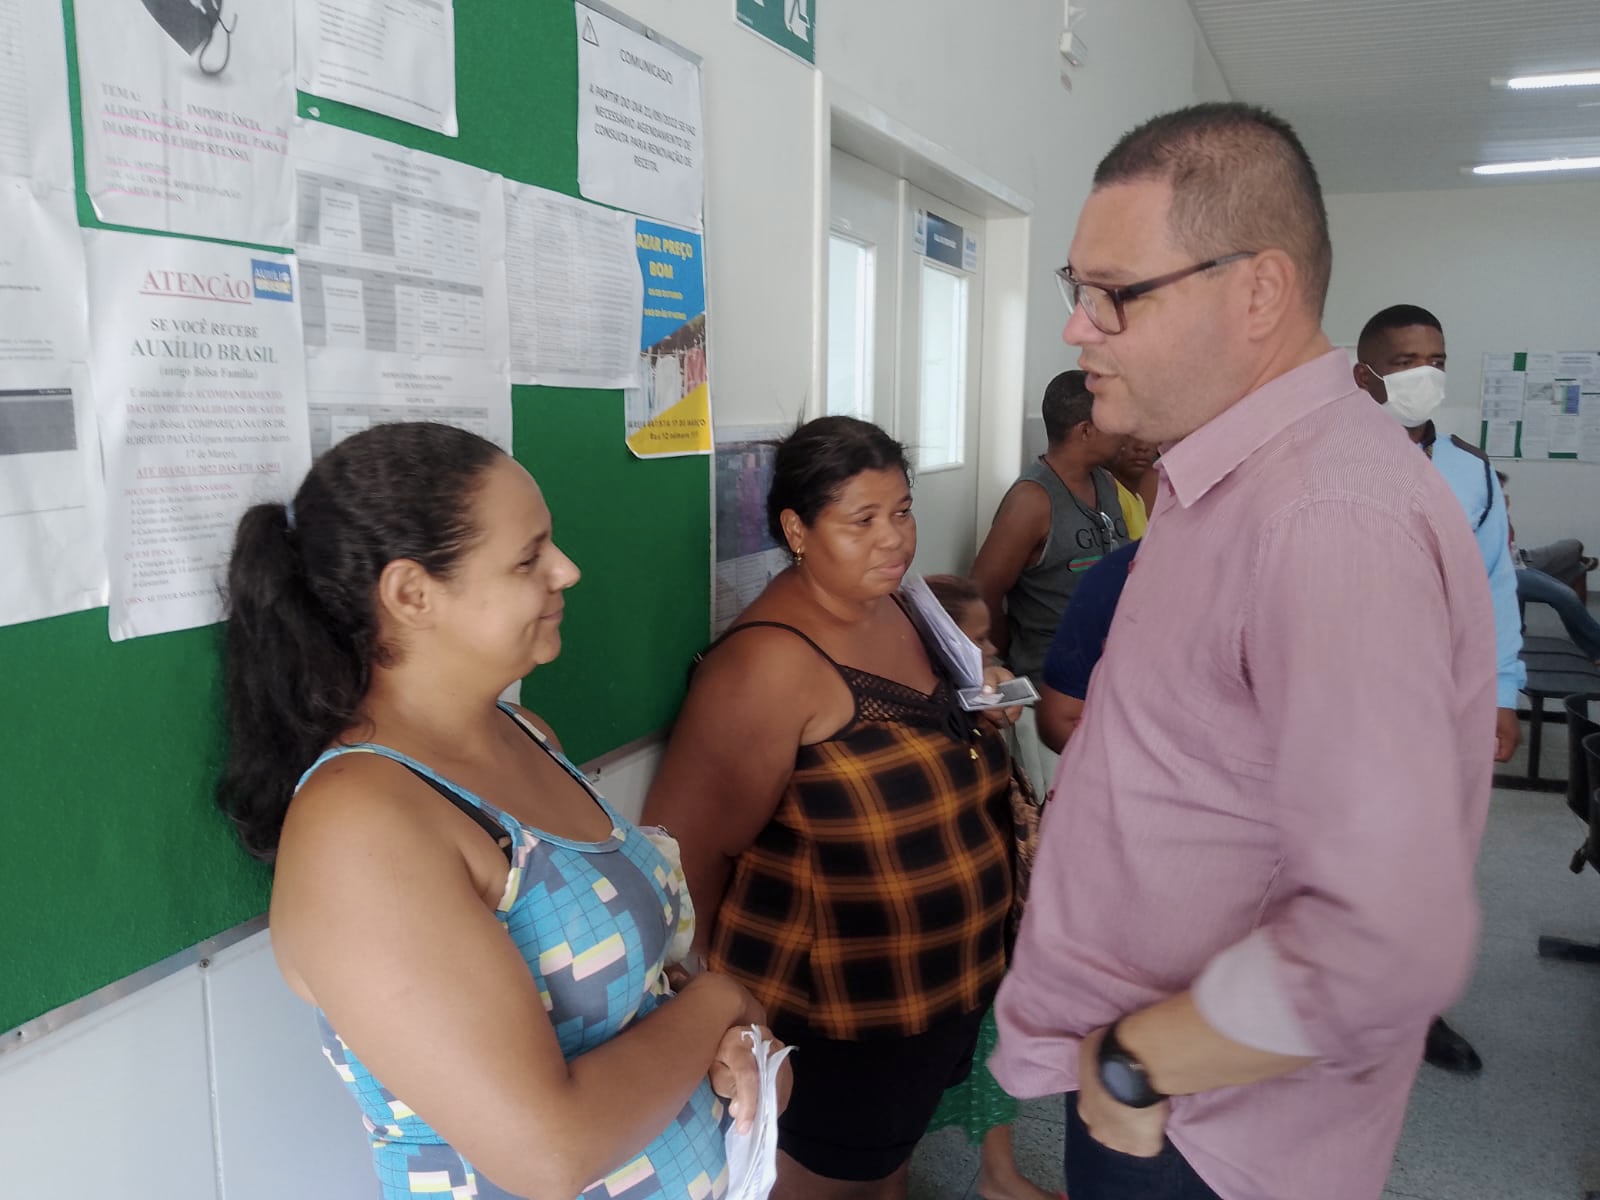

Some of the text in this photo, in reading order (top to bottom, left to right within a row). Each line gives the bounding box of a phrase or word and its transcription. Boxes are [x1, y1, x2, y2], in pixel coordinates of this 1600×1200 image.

[620, 48, 673, 85] COMUNICADO
[102, 82, 141, 101] TEMA:
[589, 83, 594, 94] A
[595, 85, 619, 104] PARTIR
[620, 95, 630, 110] DO
[630, 99, 643, 114] DIA
[103, 103, 190, 131] ALIMENTAÇÃO
[253, 137, 280, 153] PARA
[187, 103, 262, 132] IMPORTÂNCIA
[594, 104, 692, 151] NECESSÁRIO AGENDAMENTO DE
[594, 122, 629, 144] CONSULTA
[629, 135, 646, 151] PARA
[647, 142, 683, 165] RENOVAÇÃO
[636, 232, 694, 261] AZAR PREÇO
[649, 260, 674, 280] BOM
[143, 270, 250, 300] ATENÇÃO
[151, 317, 259, 339] SE VOCÊ RECEBE
[131, 336, 278, 364] AUXÍLIO BRASIL
[194, 366, 218, 378] Bolsa
[187, 418, 241, 431] COMPAREÇA
